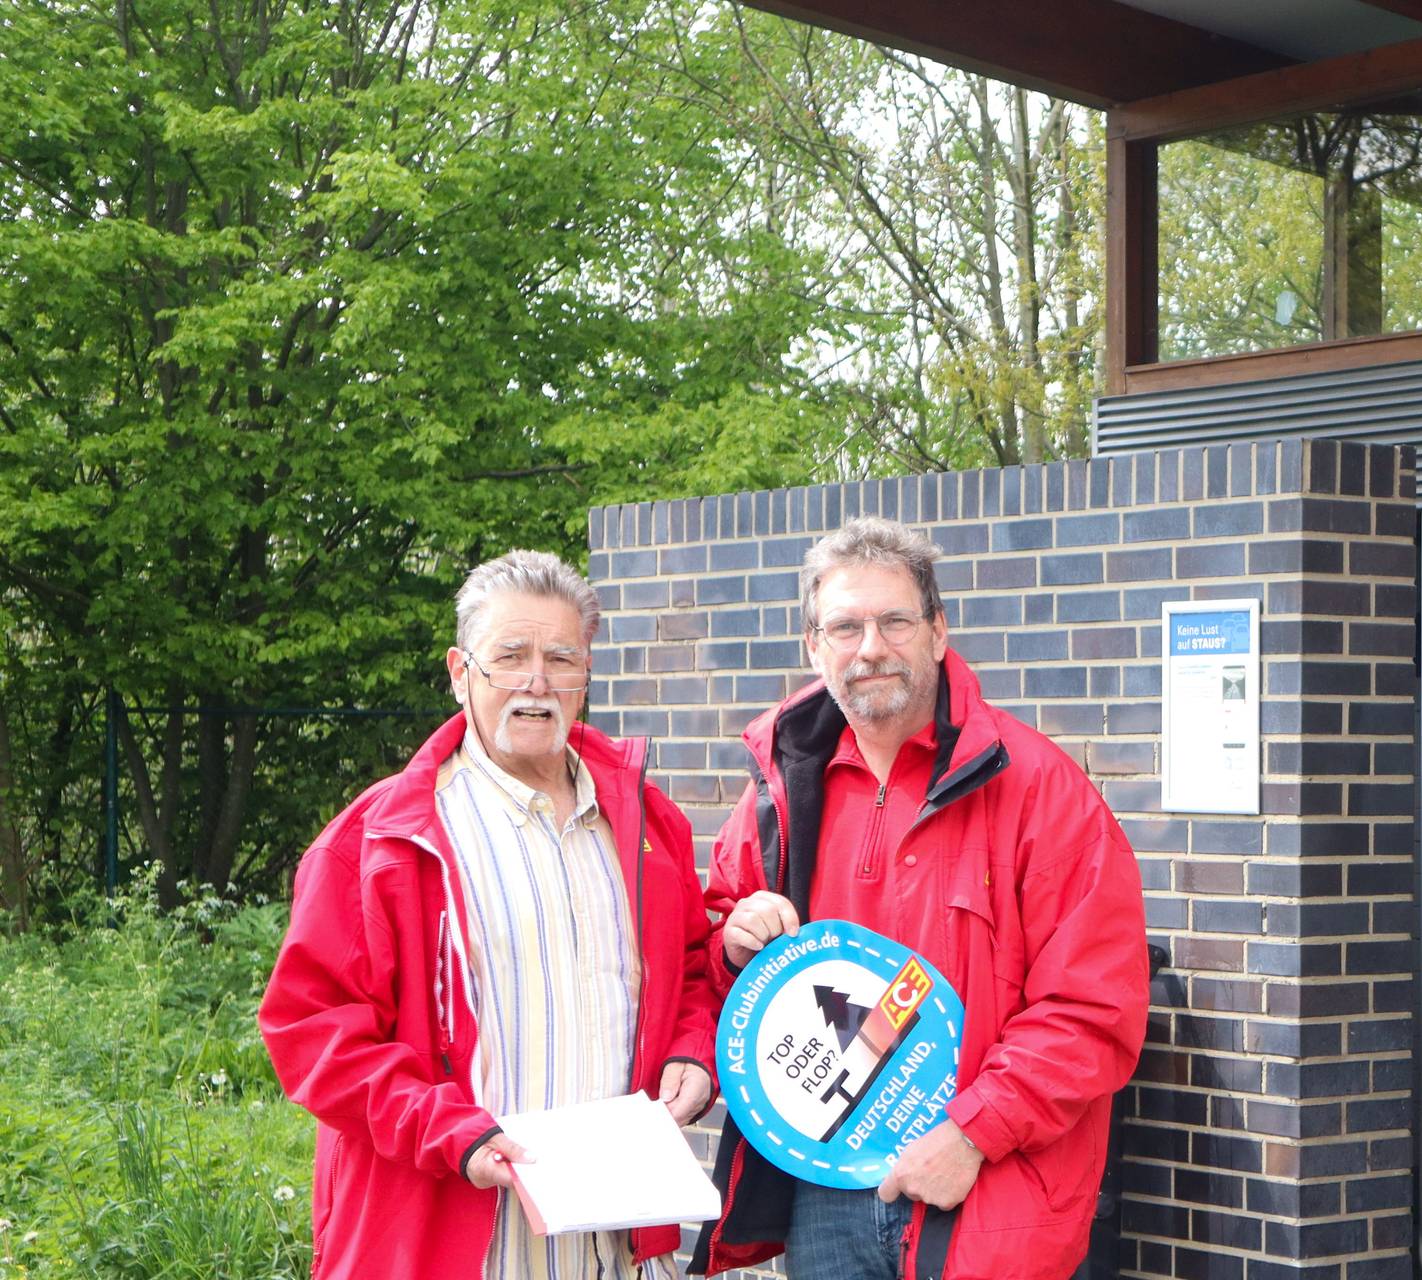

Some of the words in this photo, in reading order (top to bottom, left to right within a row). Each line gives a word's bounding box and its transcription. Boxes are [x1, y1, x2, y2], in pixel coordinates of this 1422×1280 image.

[1177, 624, 1200, 636] Keine
[1201, 624, 1219, 635] Lust
[1177, 639, 1191, 650] auf
[1191, 637, 1226, 650] STAUS?
[728, 931, 840, 1074] ACE-Clubinitiative.de
[882, 959, 930, 1028] ACE
[767, 1034, 795, 1064] TOP
[786, 1037, 824, 1079] ODER
[801, 1049, 839, 1094] FLOP?
[846, 1039, 937, 1151] DEUTSCHLAND,
[885, 1084, 925, 1134] DEINE
